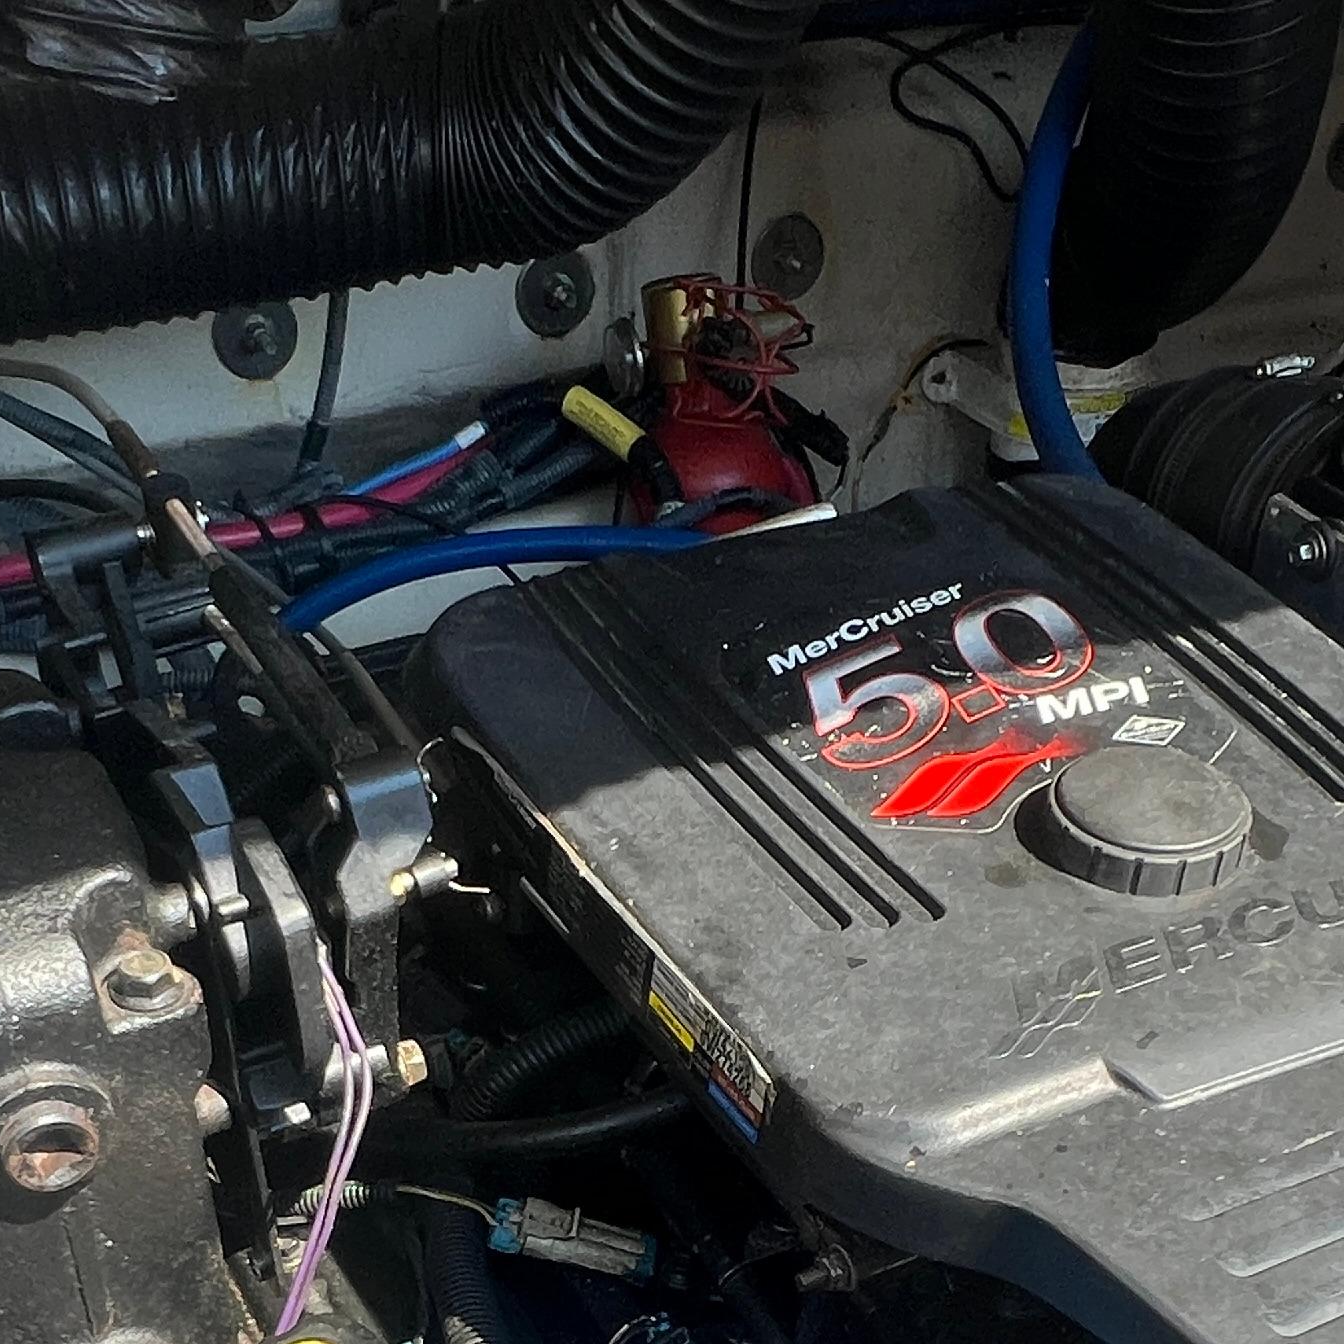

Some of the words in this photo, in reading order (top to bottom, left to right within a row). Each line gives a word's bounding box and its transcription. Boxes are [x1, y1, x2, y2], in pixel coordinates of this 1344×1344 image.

[766, 581, 964, 676] MerCruiser
[802, 588, 1095, 770] 5.0
[1034, 675, 1151, 726] MPI
